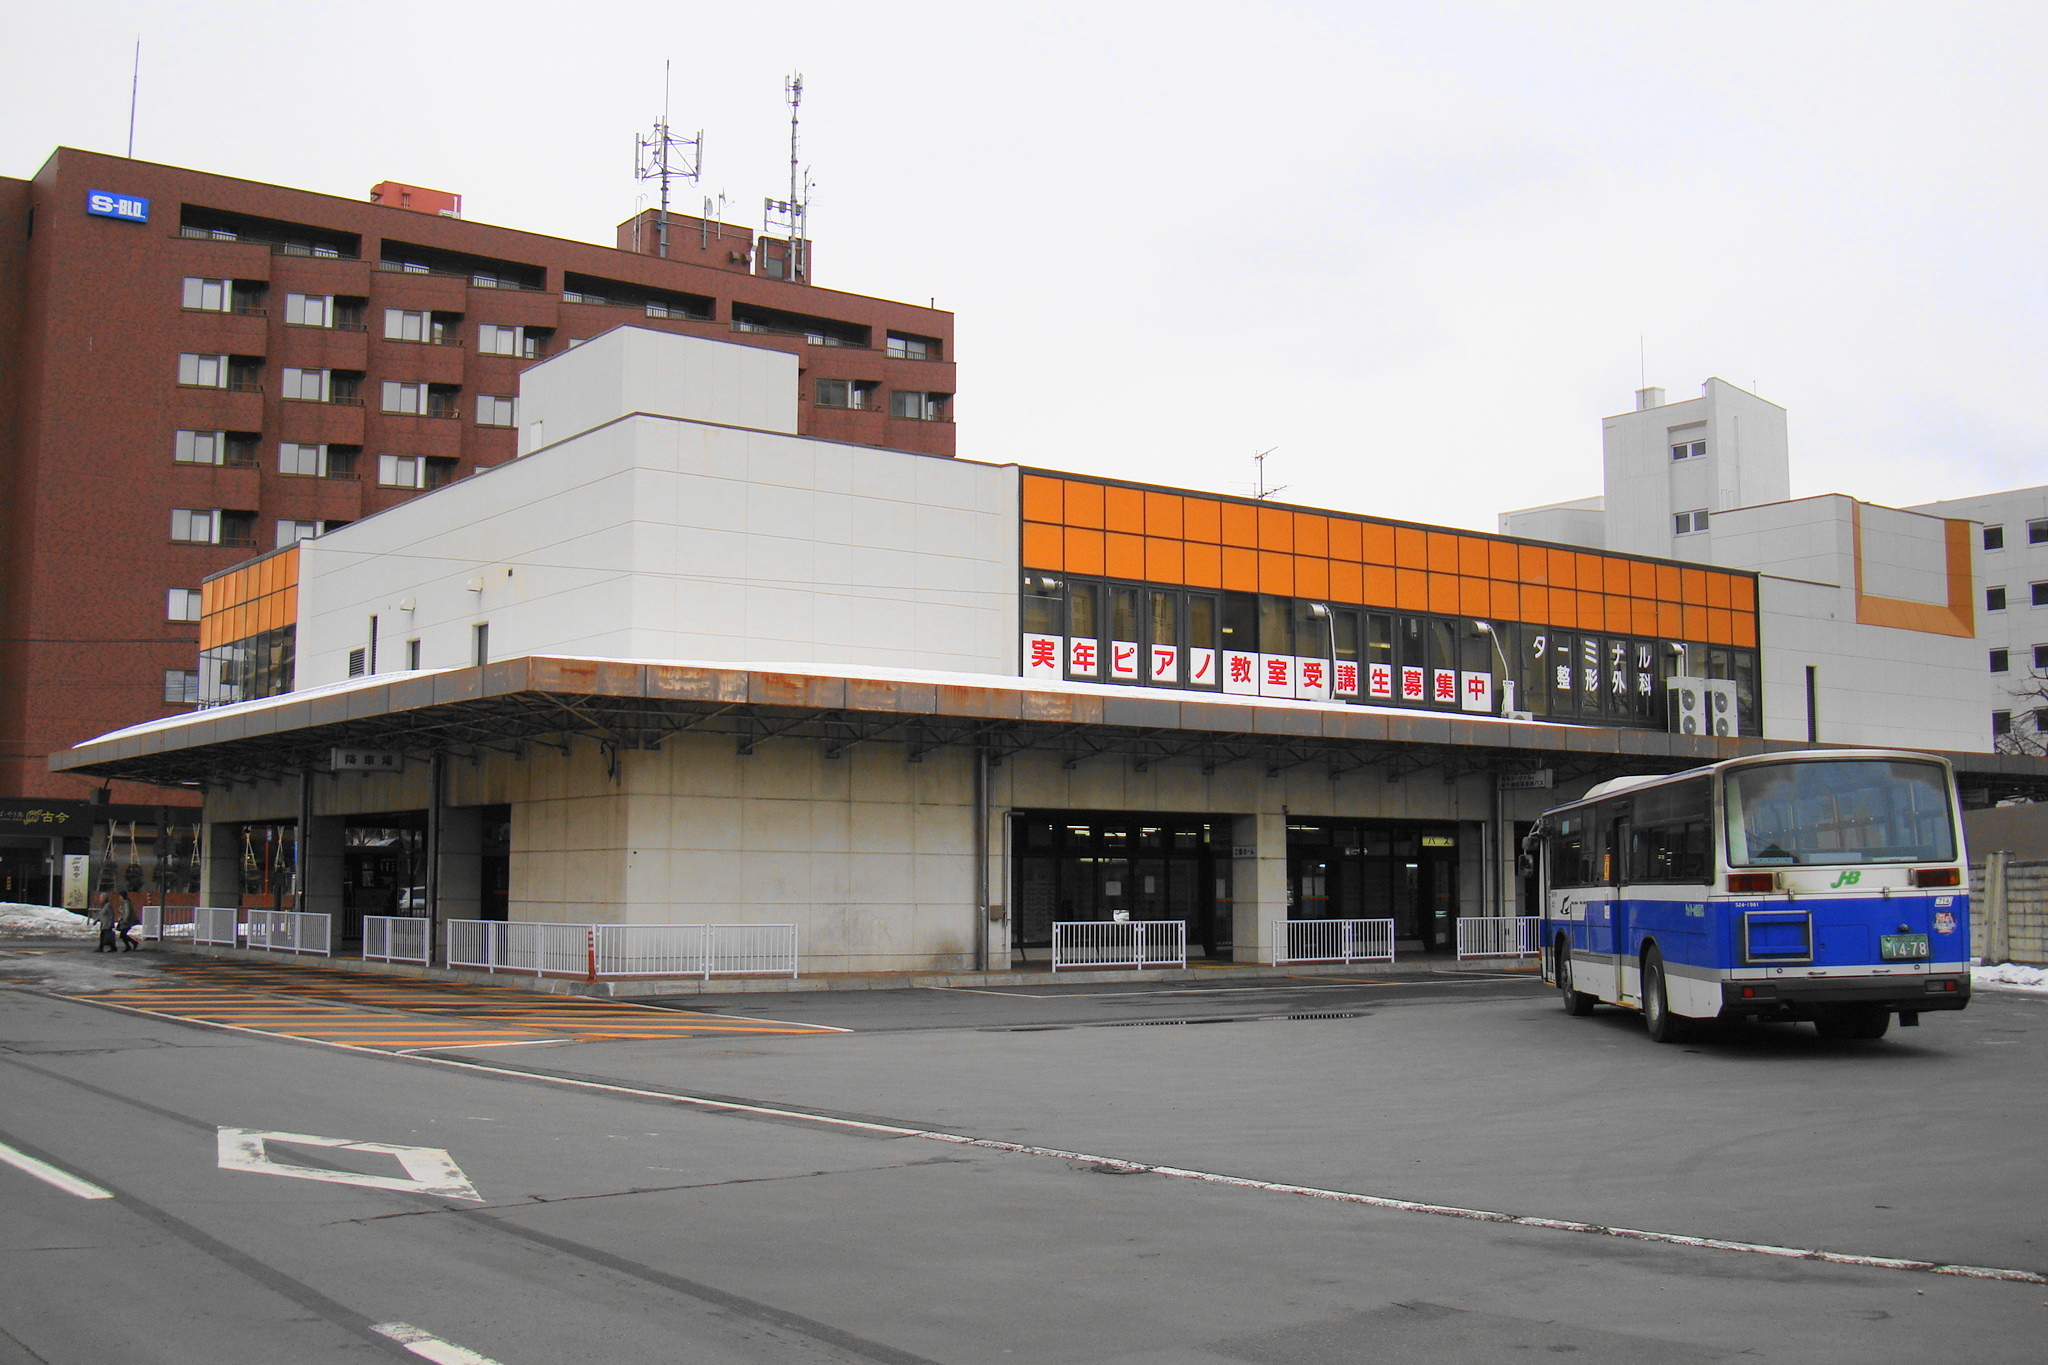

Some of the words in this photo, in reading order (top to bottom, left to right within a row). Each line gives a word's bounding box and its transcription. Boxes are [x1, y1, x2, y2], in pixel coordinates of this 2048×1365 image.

[1533, 634, 1651, 670] ターミナル
[1031, 639, 1485, 701] 実年ピアノ教室受講生募集中
[1556, 664, 1652, 697] 整形外科
[40, 811, 70, 824] 古今
[1892, 942, 1927, 957] 14-78
